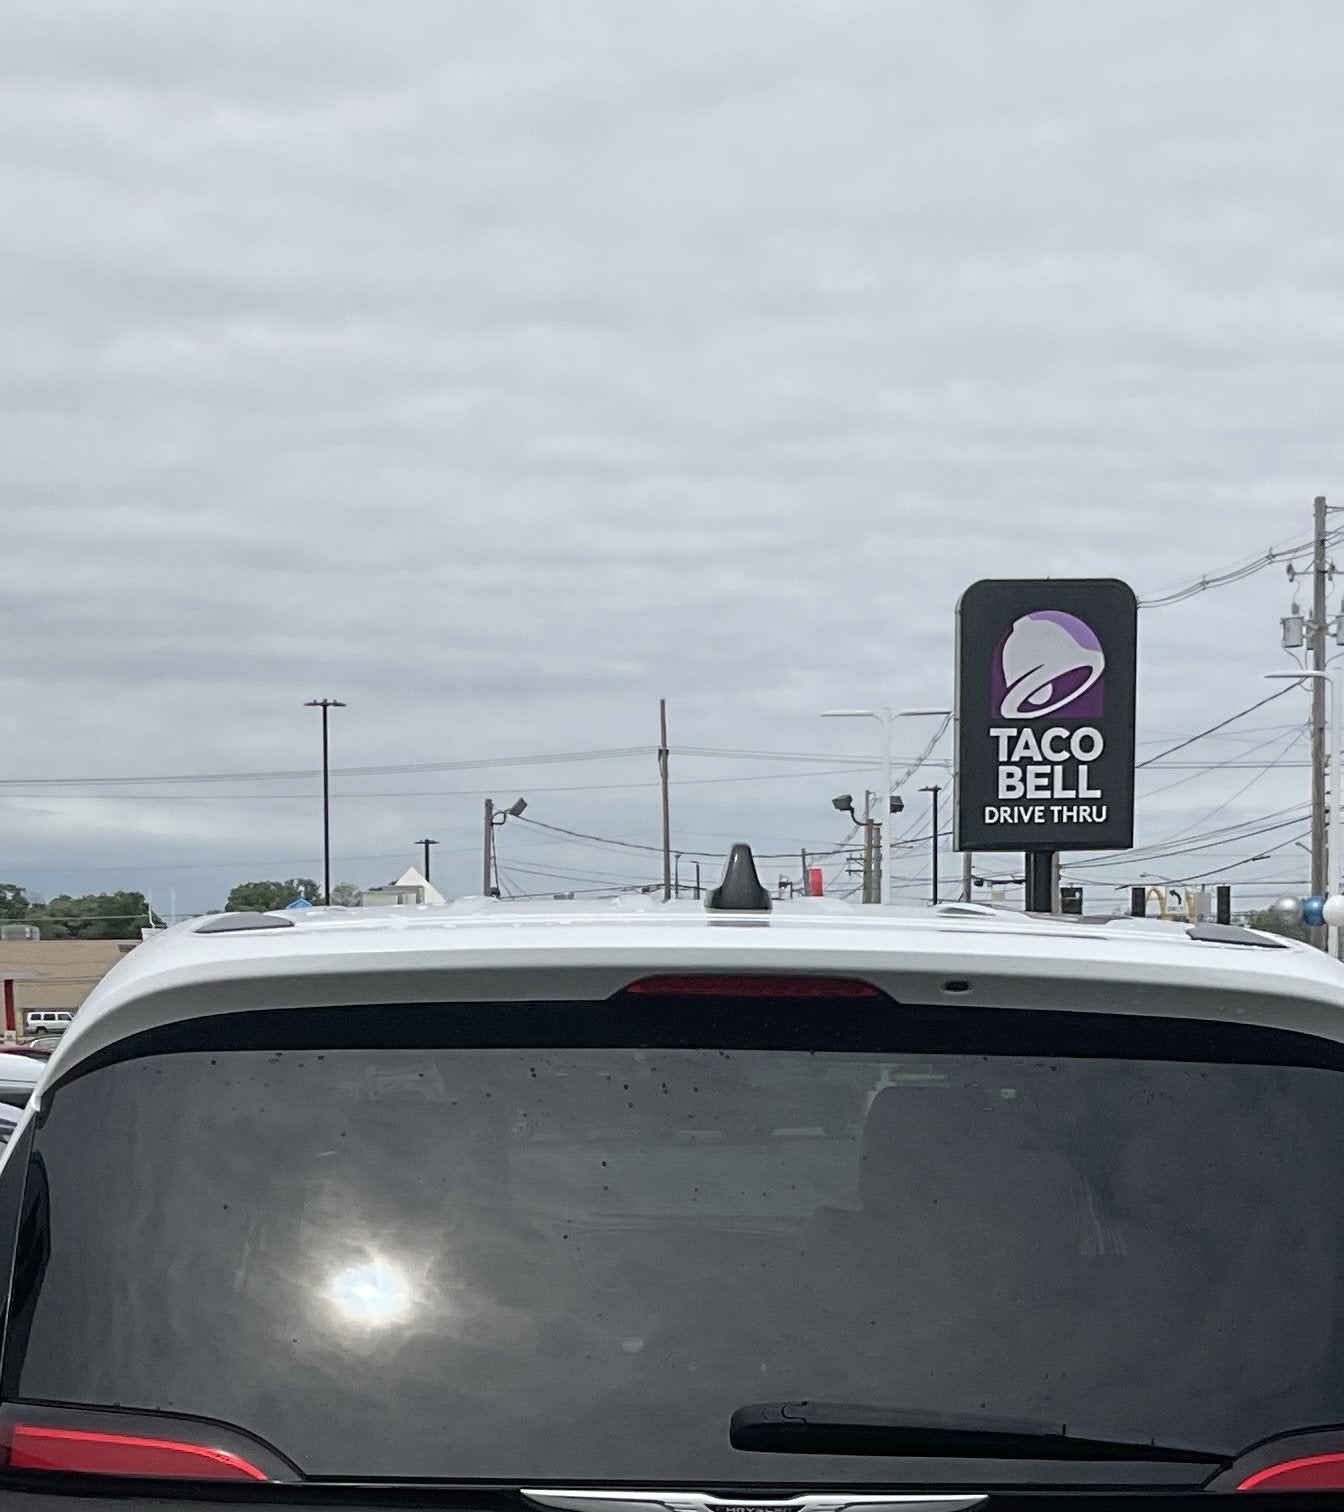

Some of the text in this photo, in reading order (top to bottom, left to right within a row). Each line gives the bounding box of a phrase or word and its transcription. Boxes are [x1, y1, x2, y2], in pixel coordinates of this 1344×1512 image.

[989, 726, 1105, 762] TACO
[998, 764, 1102, 799] BELL
[984, 805, 1107, 824] DRIVE THRU
